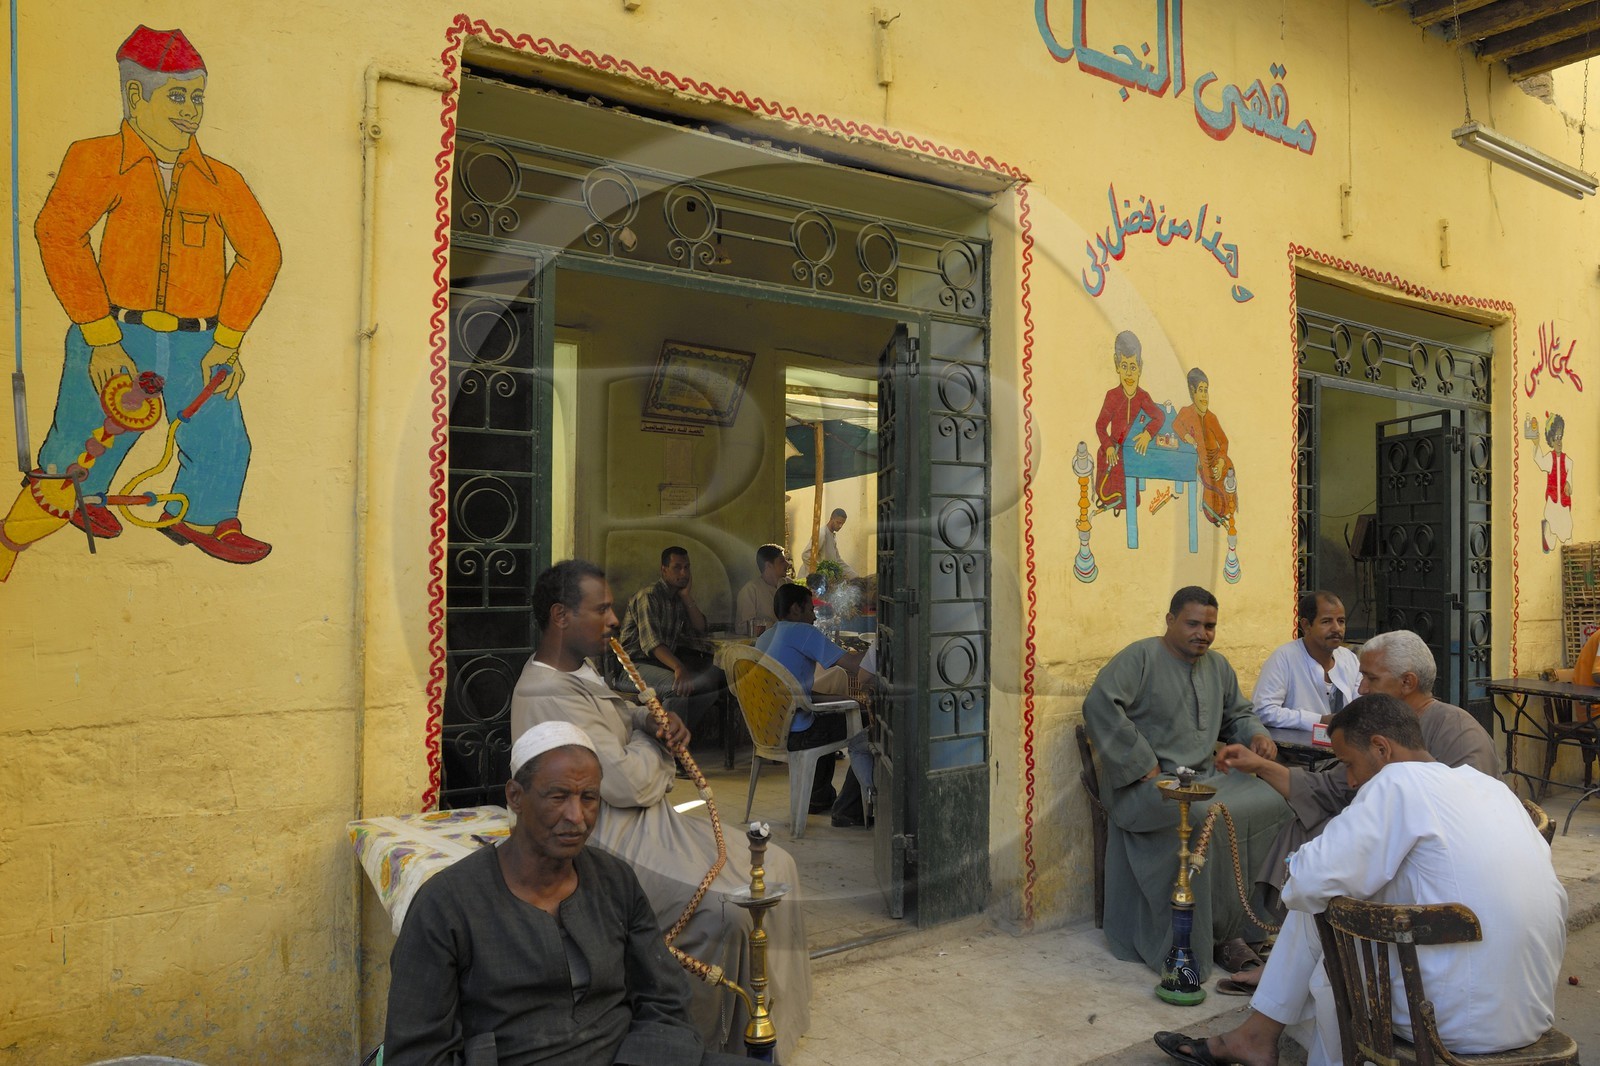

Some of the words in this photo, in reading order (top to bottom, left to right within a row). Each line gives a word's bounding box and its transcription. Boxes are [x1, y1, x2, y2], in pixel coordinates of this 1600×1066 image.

[1194, 62, 1317, 155] مقهى
[1106, 182, 1157, 261] فضل
[1157, 205, 1193, 246] من
